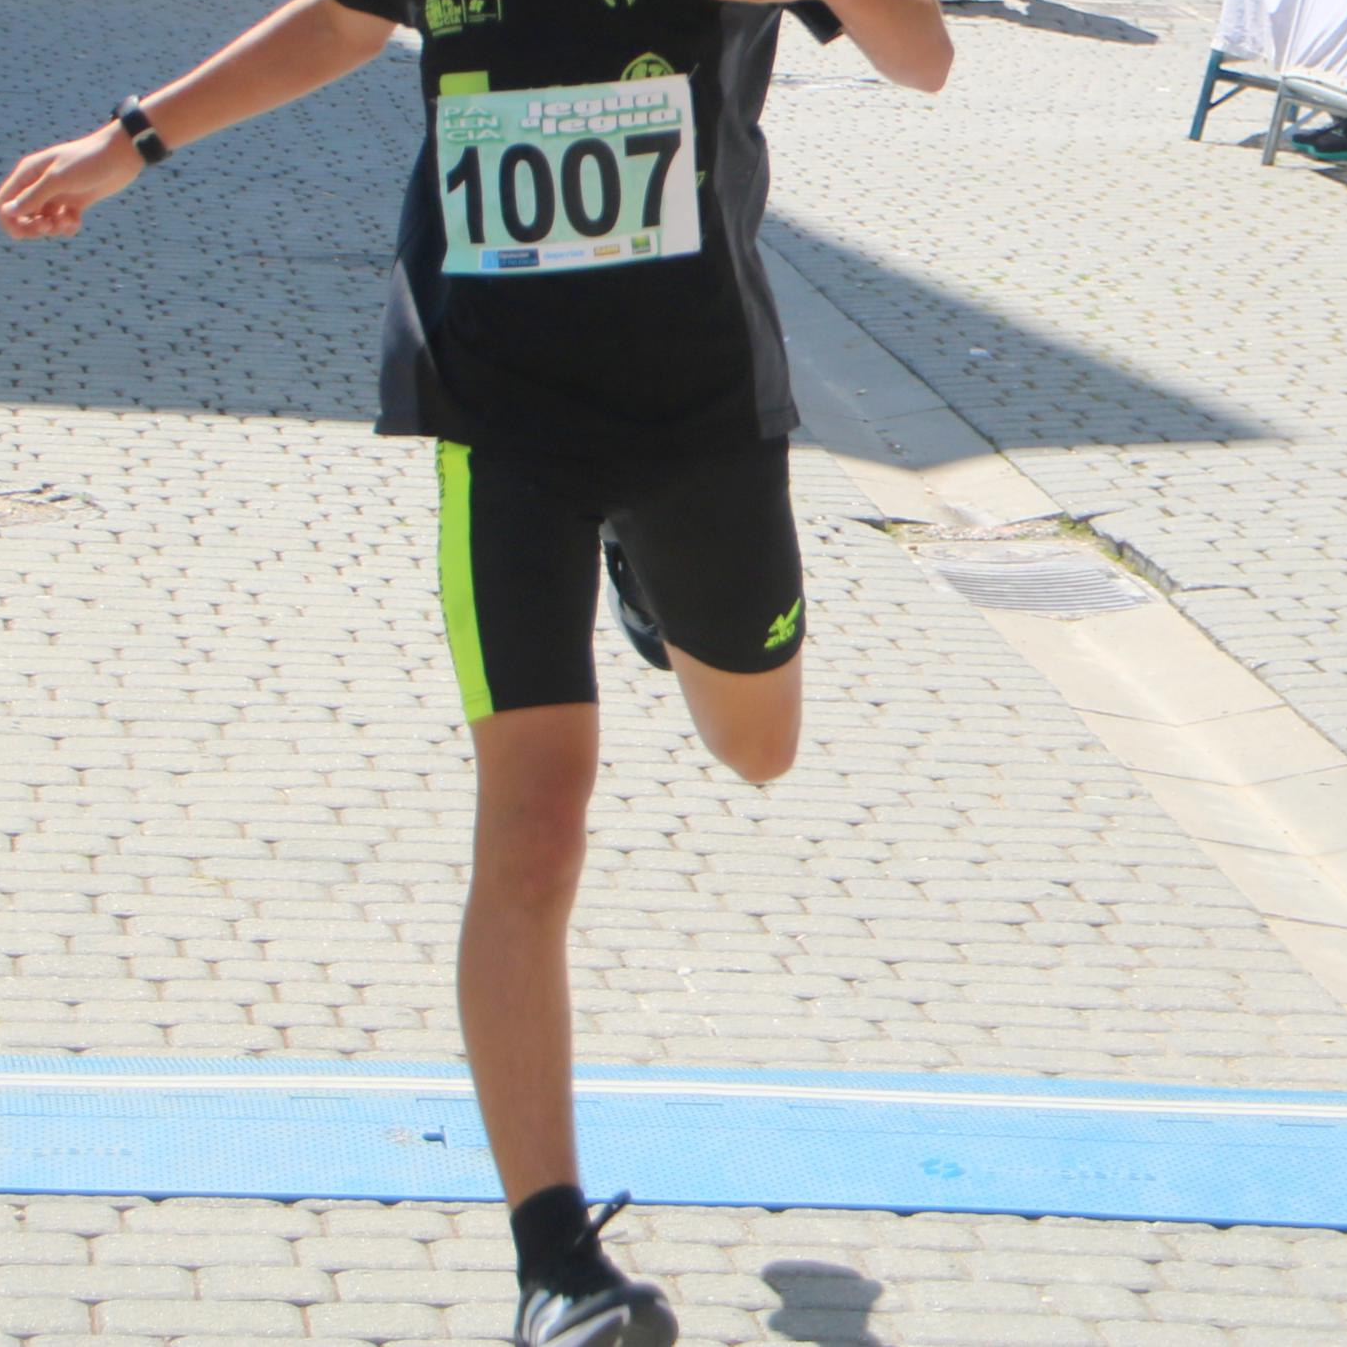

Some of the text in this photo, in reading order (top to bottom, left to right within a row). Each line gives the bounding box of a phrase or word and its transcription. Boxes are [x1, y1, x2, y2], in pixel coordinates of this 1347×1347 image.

[444, 104, 490, 118] PA
[527, 91, 669, 120] legua
[443, 115, 499, 129] LEN
[541, 108, 681, 135] legua
[446, 128, 502, 142] CIA
[446, 128, 682, 245] 1007
